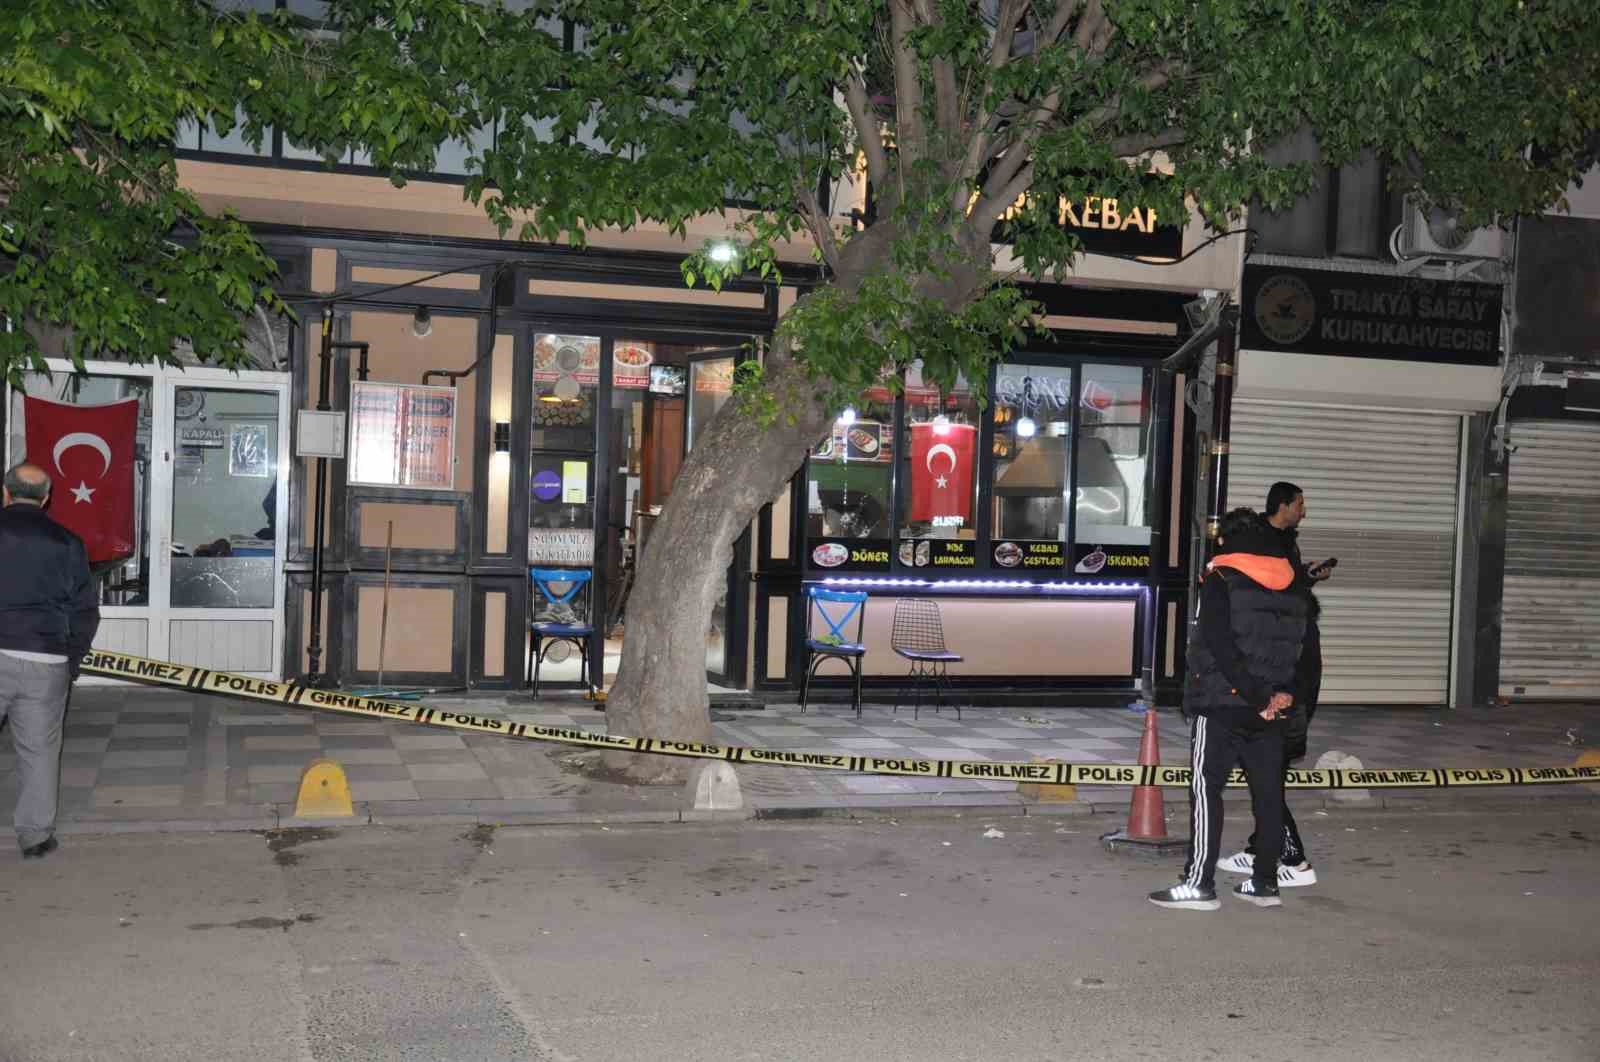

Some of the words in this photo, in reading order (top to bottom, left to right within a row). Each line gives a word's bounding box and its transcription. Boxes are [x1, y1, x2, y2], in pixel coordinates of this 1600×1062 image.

[1329, 288, 1411, 317] TRAKYA
[1418, 297, 1488, 321] SARAY
[852, 549, 889, 563] DÖNER
